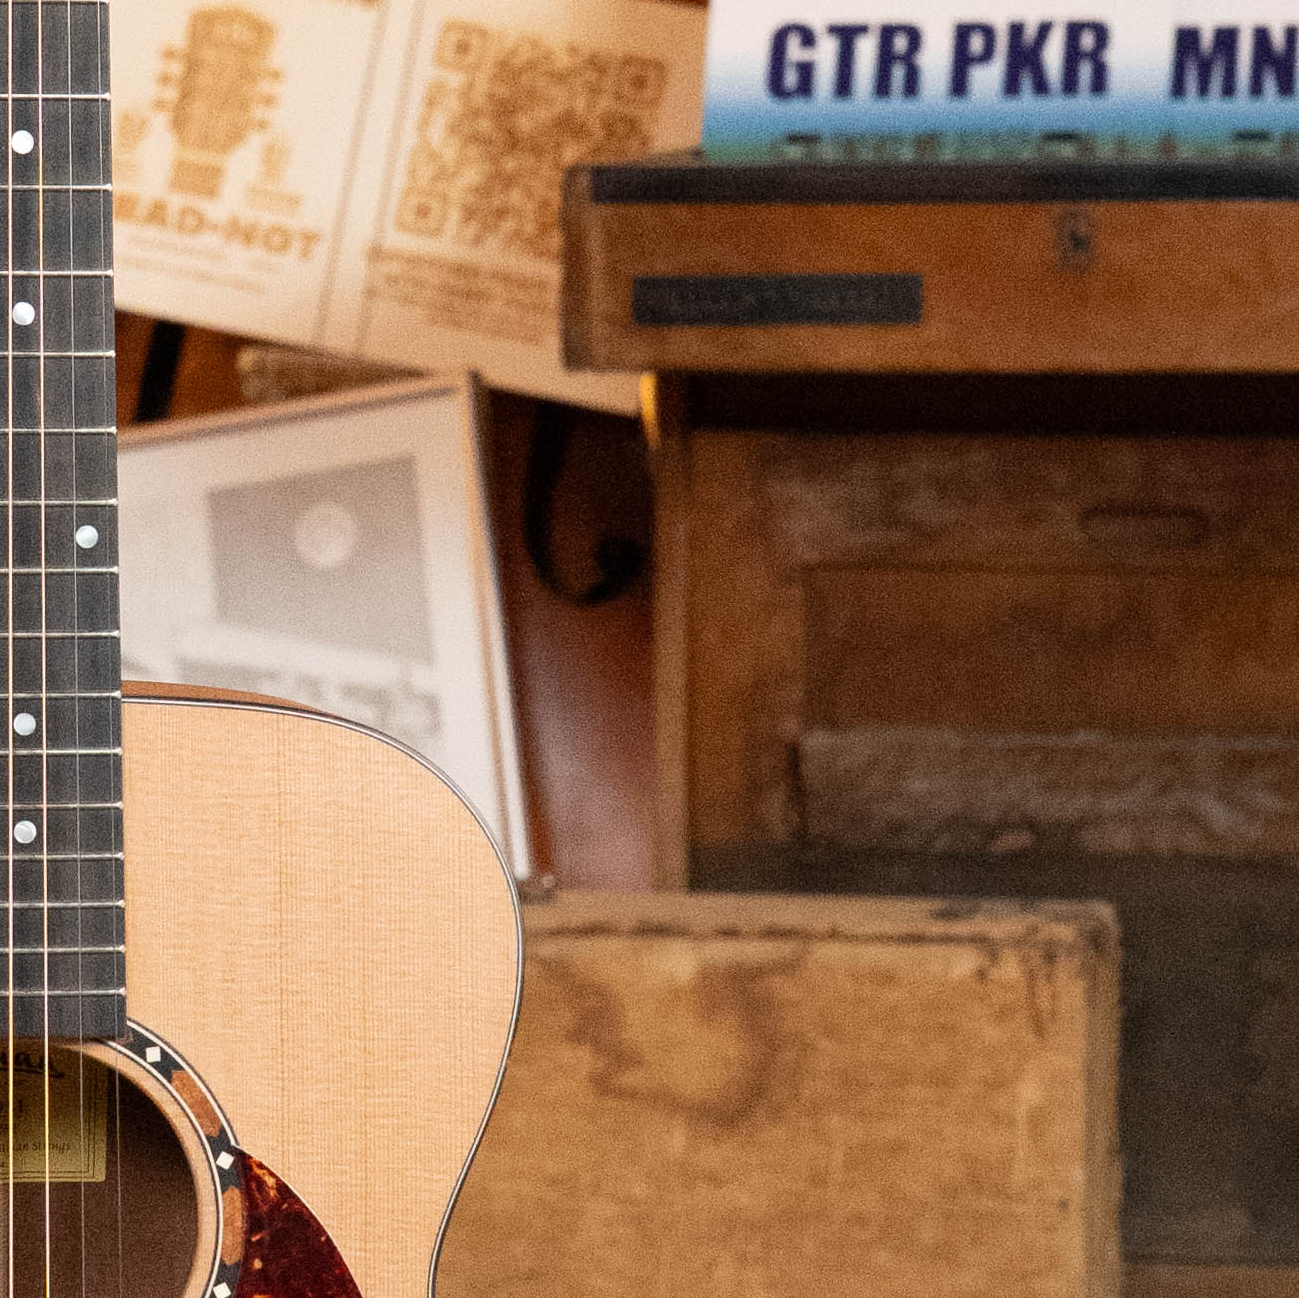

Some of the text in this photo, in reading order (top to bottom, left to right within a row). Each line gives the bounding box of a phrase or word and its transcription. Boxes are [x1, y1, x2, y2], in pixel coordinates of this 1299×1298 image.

[766, 20, 1111, 101] GTR PKR
[1169, 24, 1299, 100] MN
